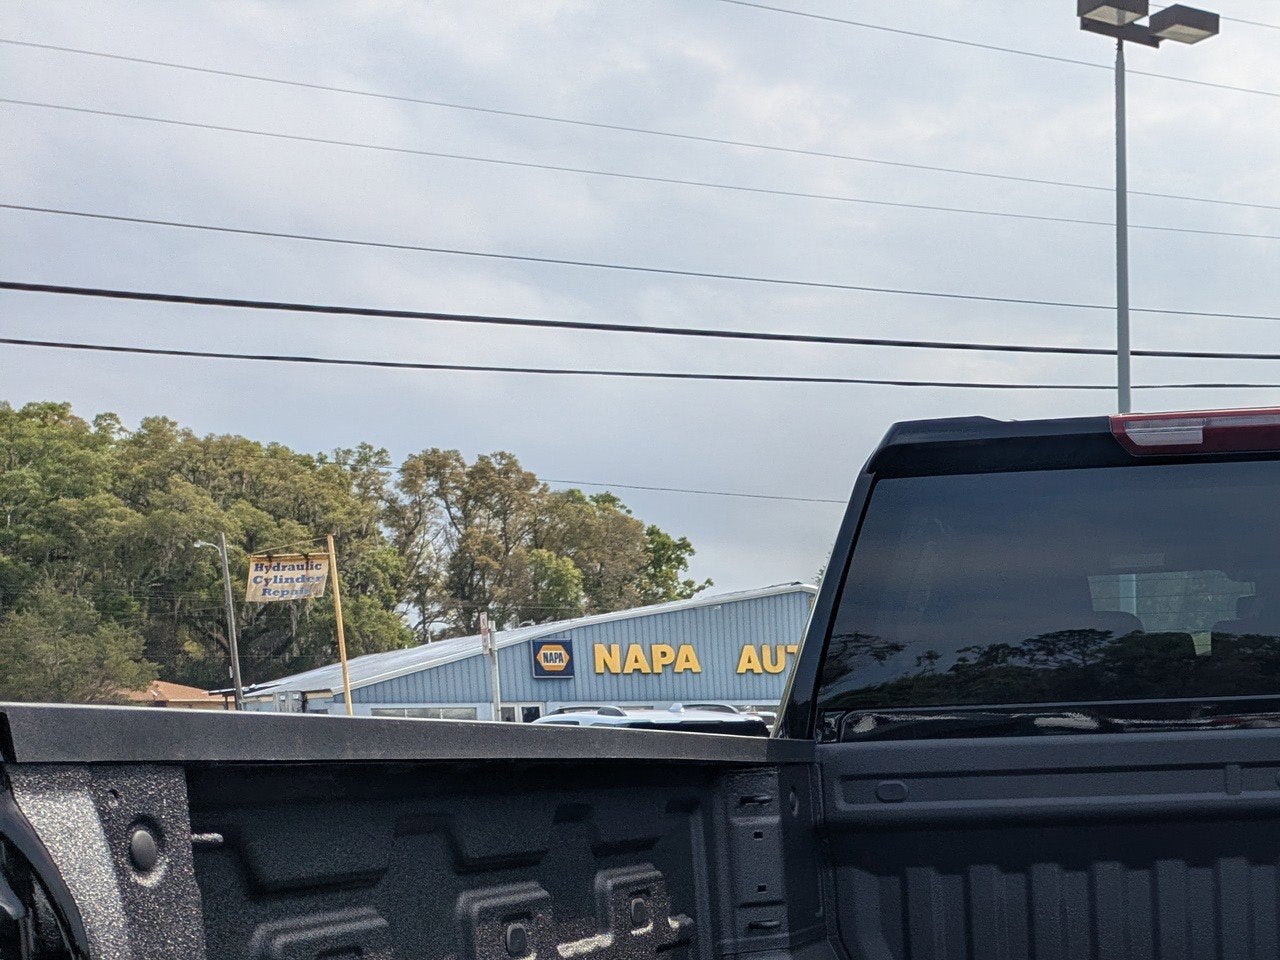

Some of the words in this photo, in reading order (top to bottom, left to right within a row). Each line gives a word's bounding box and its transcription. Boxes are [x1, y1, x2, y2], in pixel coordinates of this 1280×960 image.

[254, 562, 322, 574] Hydraulic
[252, 575, 325, 587] Cylinder
[542, 652, 564, 664] NAPA
[593, 643, 702, 675] NAPA
